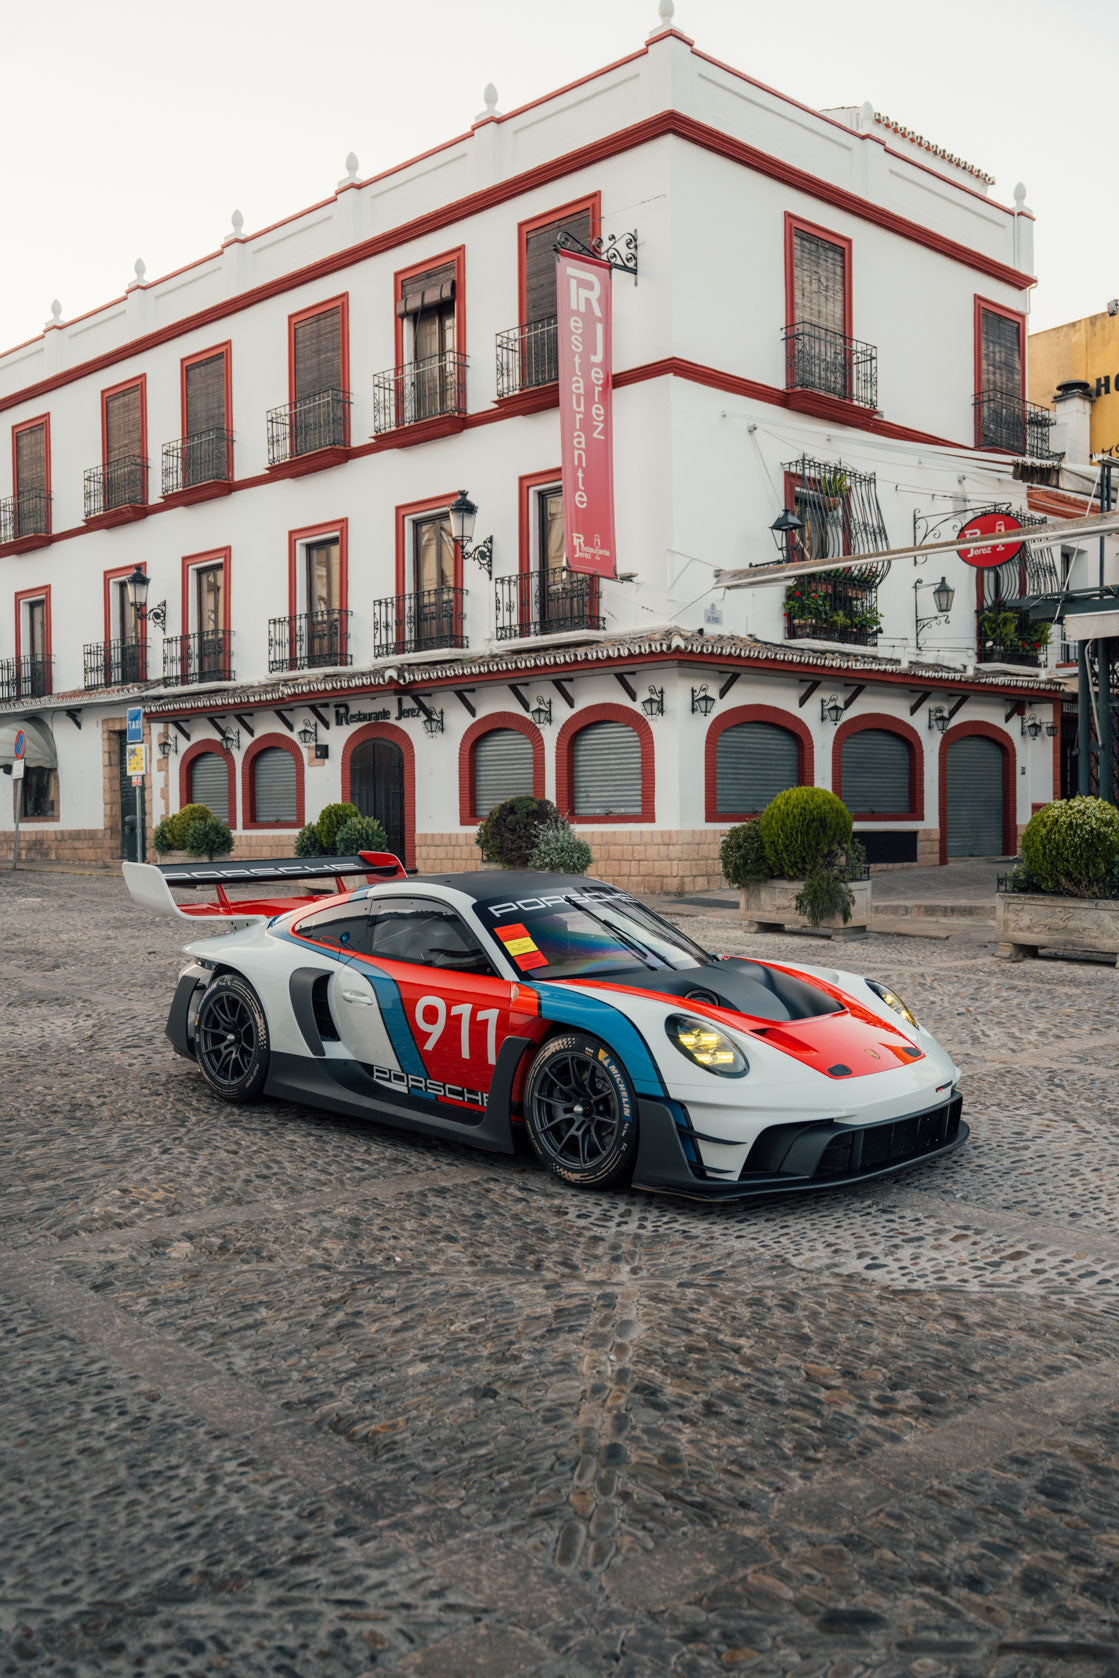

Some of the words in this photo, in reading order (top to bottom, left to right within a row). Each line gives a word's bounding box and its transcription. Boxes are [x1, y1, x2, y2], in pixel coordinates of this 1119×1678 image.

[566, 266, 602, 509] Restaurante
[590, 322, 605, 440] Jerez
[967, 546, 992, 557] Jerez
[128, 720, 142, 729] TAXI
[334, 703, 391, 726] Restaurante
[395, 697, 421, 721] Jerez
[163, 863, 362, 879] PORSCHE
[488, 892, 639, 918] PORSCHE
[414, 995, 500, 1065] 911
[608, 1064, 631, 1118] MICHELIN
